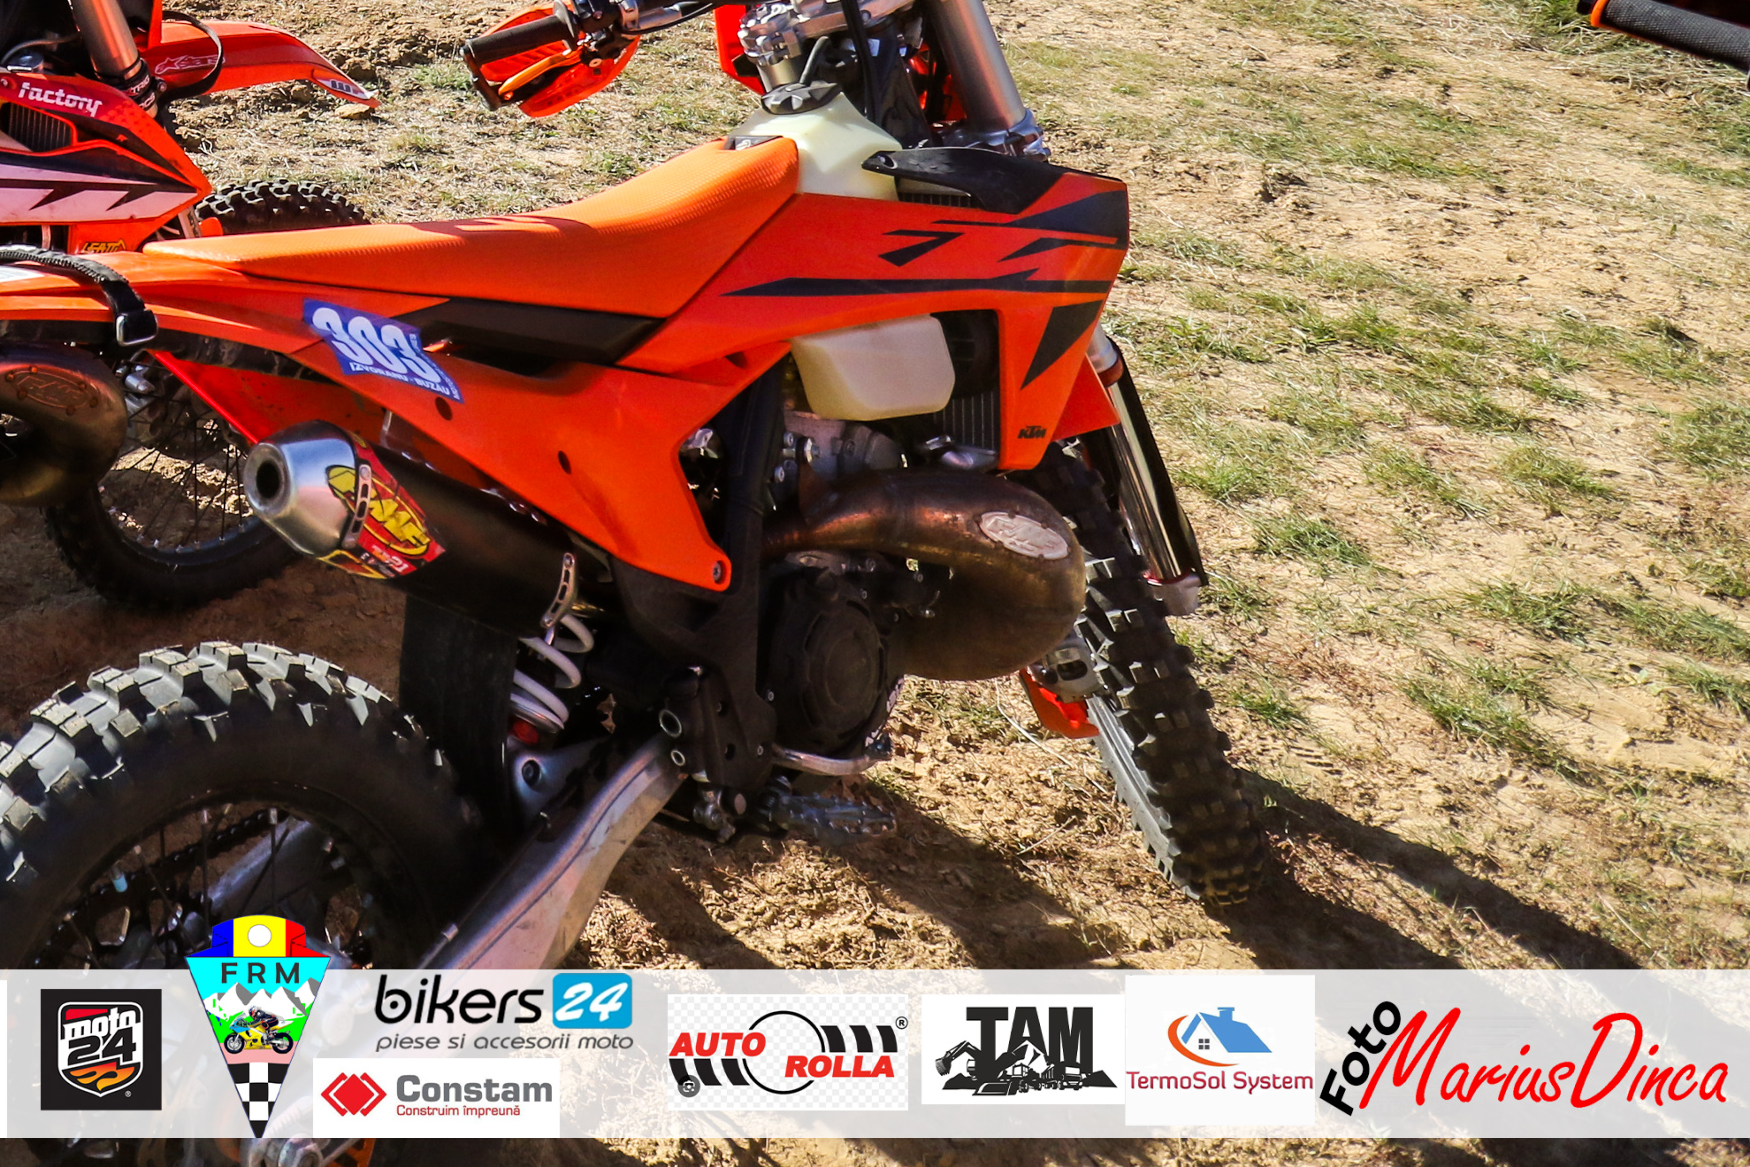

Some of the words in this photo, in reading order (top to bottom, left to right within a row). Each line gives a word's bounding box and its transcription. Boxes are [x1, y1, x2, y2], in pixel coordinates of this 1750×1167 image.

[18, 82, 102, 117] factory
[312, 307, 442, 384] 303
[1017, 425, 1047, 440] KTM
